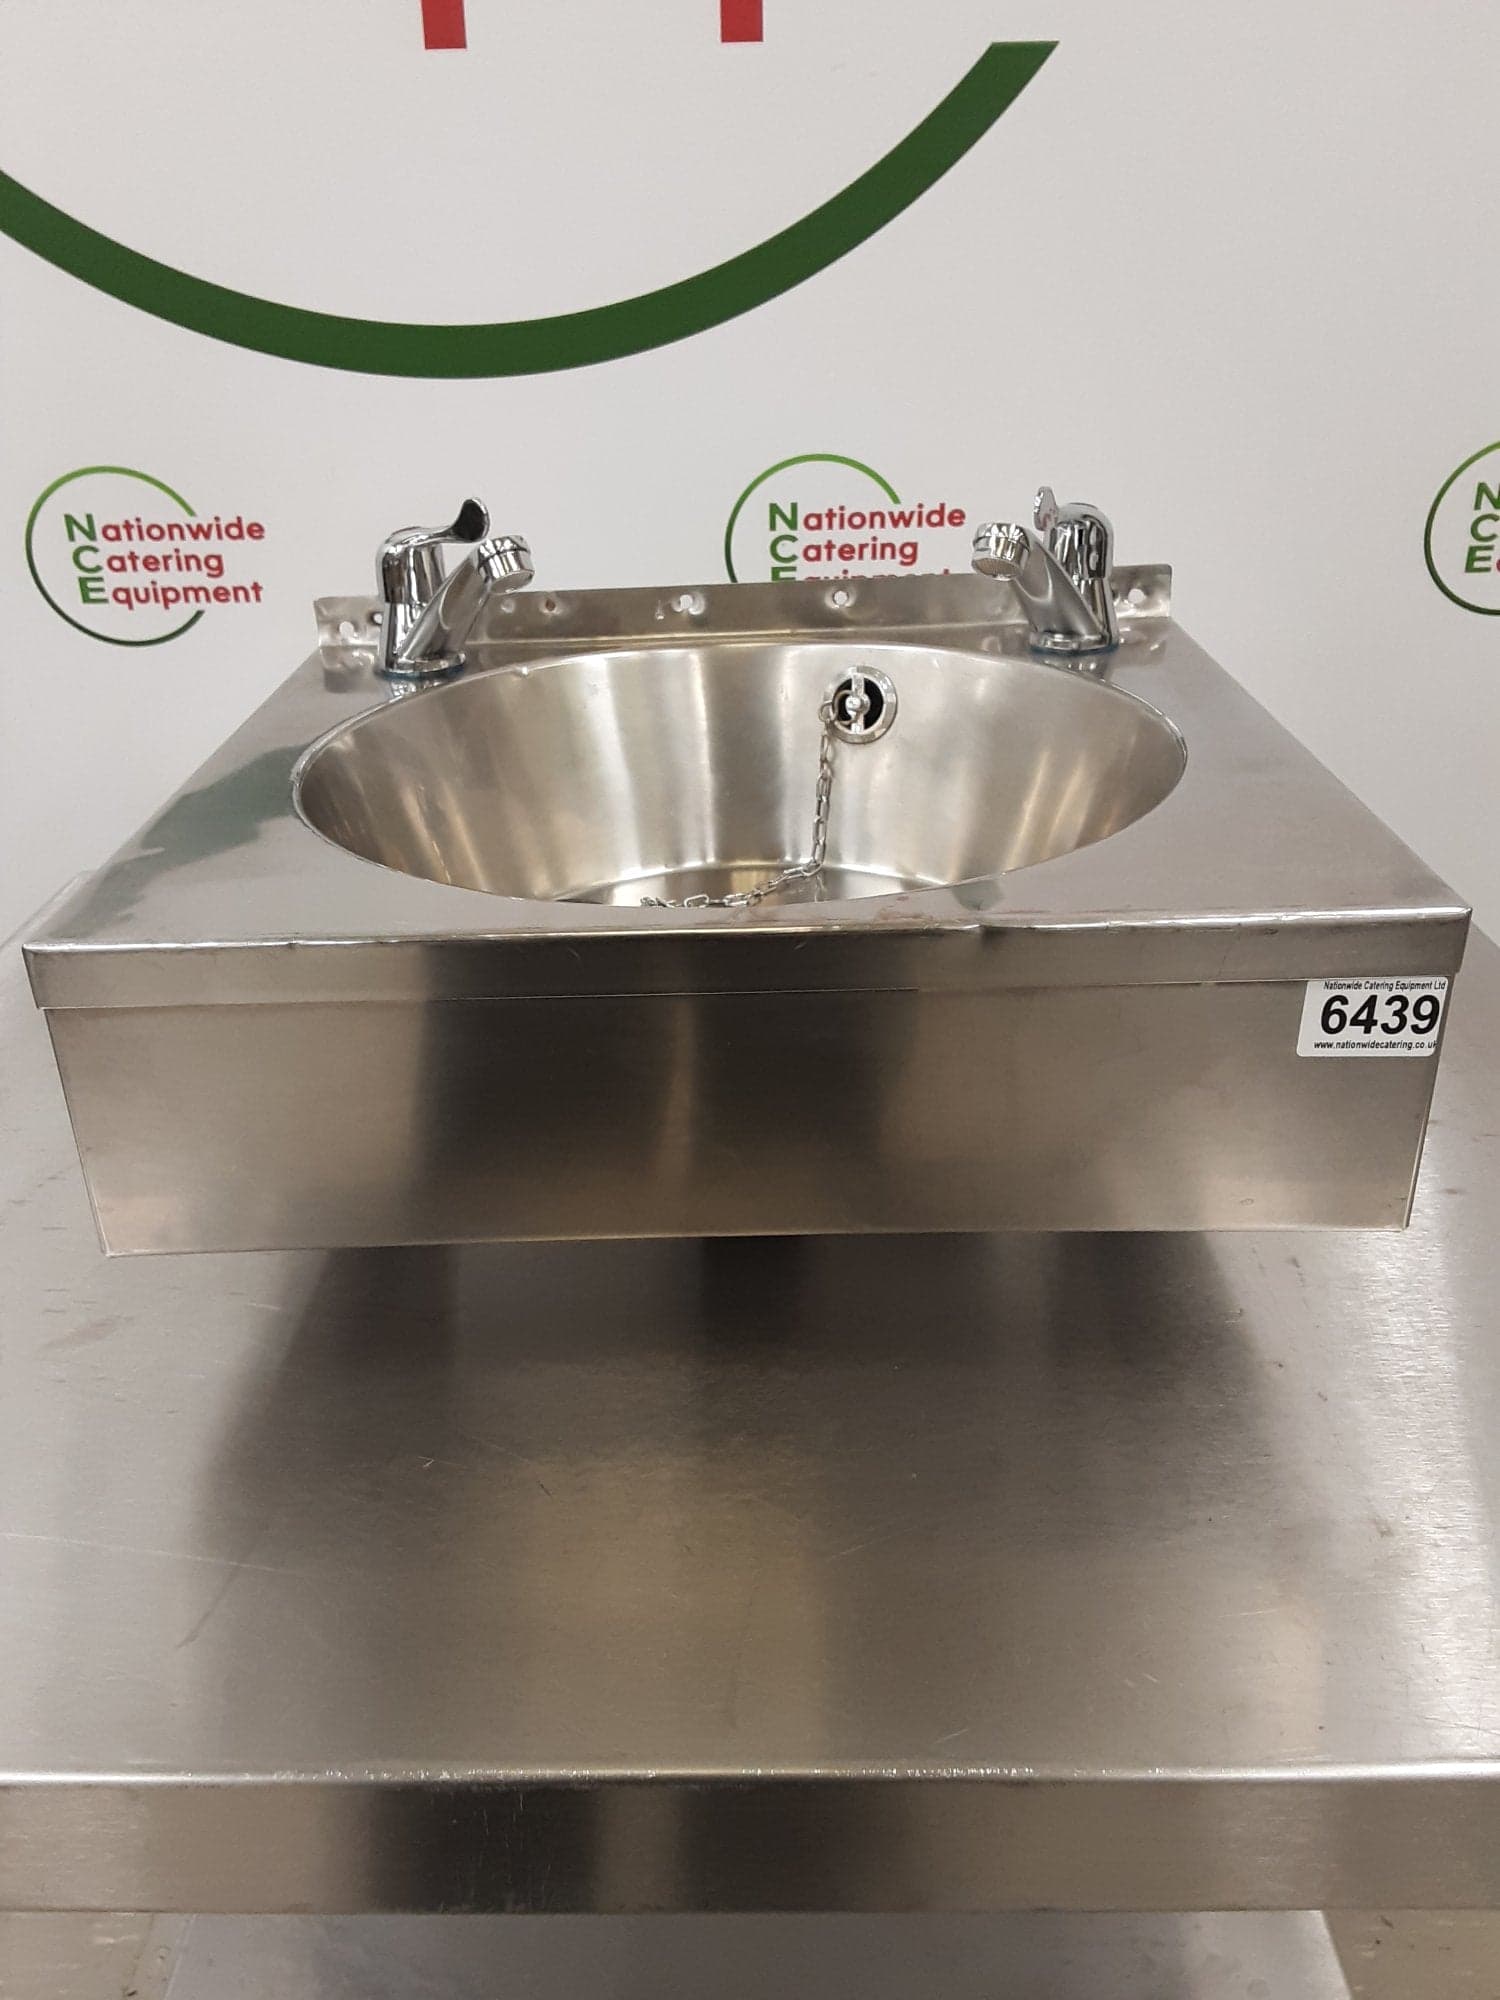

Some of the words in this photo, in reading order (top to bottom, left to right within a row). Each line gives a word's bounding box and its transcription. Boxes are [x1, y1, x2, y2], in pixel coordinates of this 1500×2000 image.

[64, 513, 265, 542] Nationwide
[769, 502, 966, 531] Nationwide
[72, 545, 225, 578] Catering
[770, 534, 919, 566] Catering
[1465, 544, 1500, 573] E
[78, 577, 263, 610] Equipment
[1323, 980, 1362, 990] Nationwide
[1364, 980, 1394, 991] Catering
[1395, 980, 1432, 991] Equipment
[1434, 981, 1446, 990] Ltd
[1320, 994, 1440, 1035] 6439
